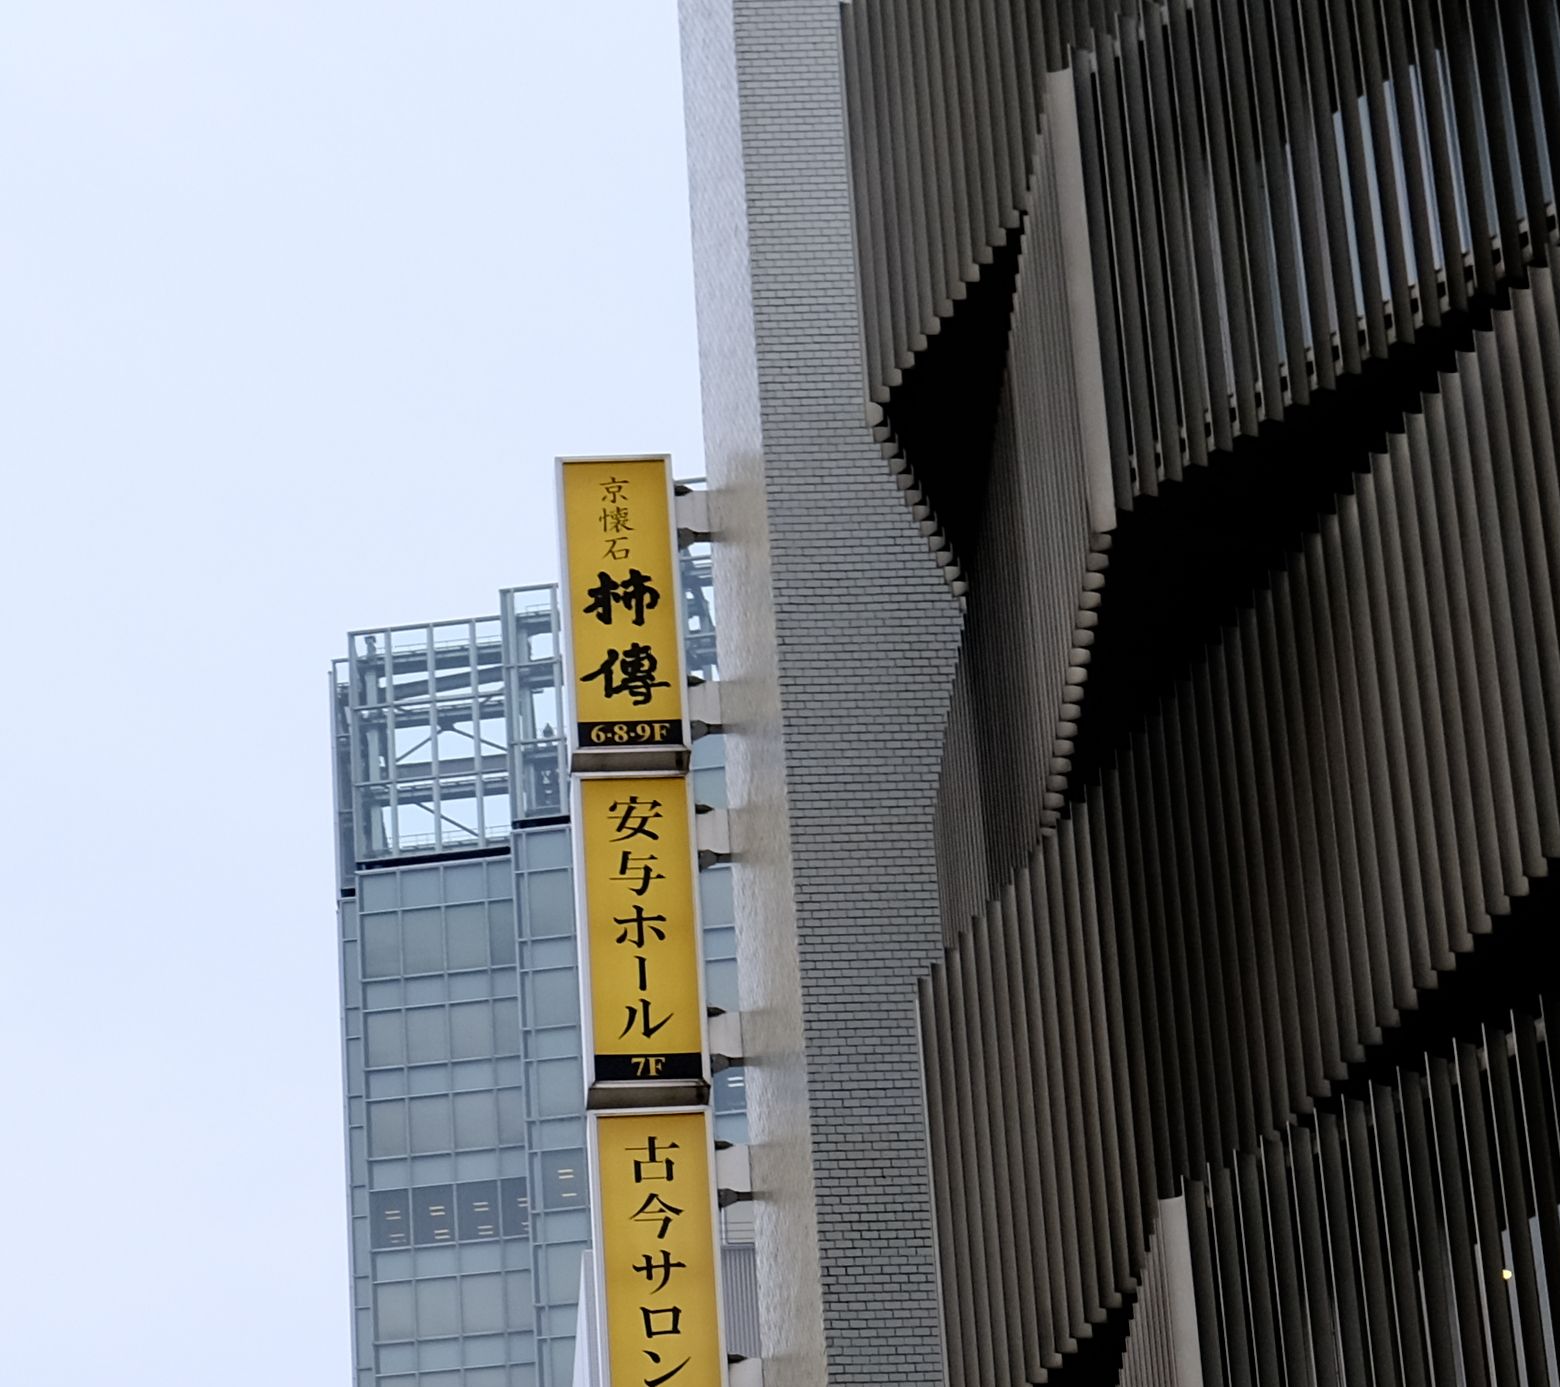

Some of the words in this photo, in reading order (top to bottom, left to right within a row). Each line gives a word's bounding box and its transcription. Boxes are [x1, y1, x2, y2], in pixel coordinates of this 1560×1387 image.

[598, 475, 635, 562] 京懐石
[579, 569, 672, 707] 柿傳
[606, 794, 675, 1041] 安与ホール
[630, 1056, 666, 1078] 7F
